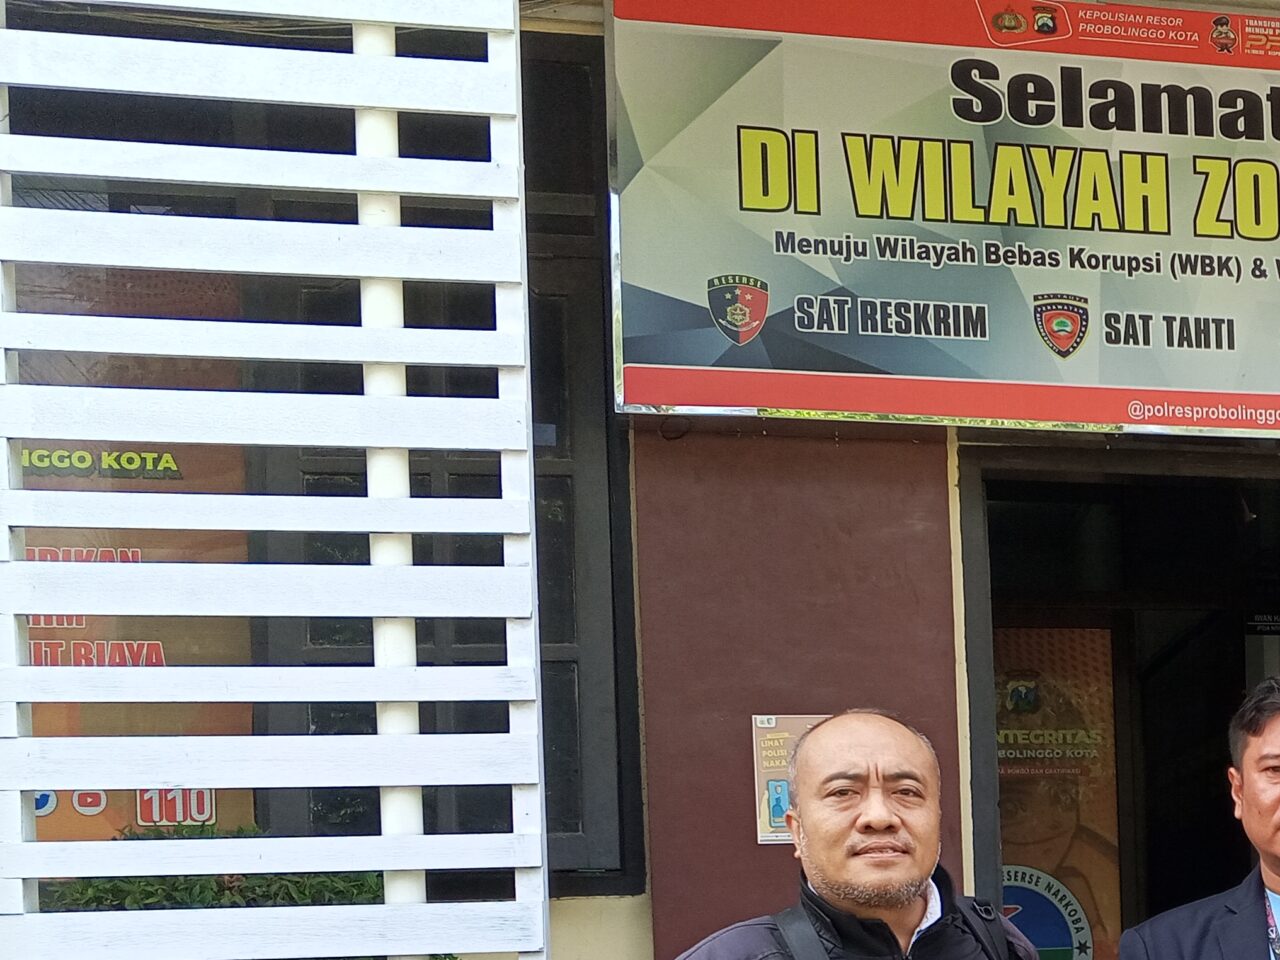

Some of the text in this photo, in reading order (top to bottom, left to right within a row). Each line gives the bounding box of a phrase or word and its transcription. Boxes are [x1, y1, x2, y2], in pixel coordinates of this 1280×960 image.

[1078, 10, 1183, 27] KEPOLISIAN RESOR
[1079, 23, 1199, 42] PROBOLINGGO KOTA
[737, 126, 821, 215] DI
[842, 133, 1168, 235] WILAYAH
[774, 231, 868, 262] Menuju
[876, 236, 976, 267] Wilayah
[985, 242, 1060, 268] Bebas
[1069, 247, 1161, 277] Korupsi
[1170, 253, 1242, 283] (WBK)
[1251, 258, 1268, 279] &
[797, 297, 988, 339] SAT RESKRIM
[1105, 311, 1153, 346] SAT
[1163, 315, 1236, 351] TAHTI
[102, 451, 178, 471] KOTA
[1065, 749, 1100, 758] KOTA
[1044, 881, 1085, 935] NARKOBA
